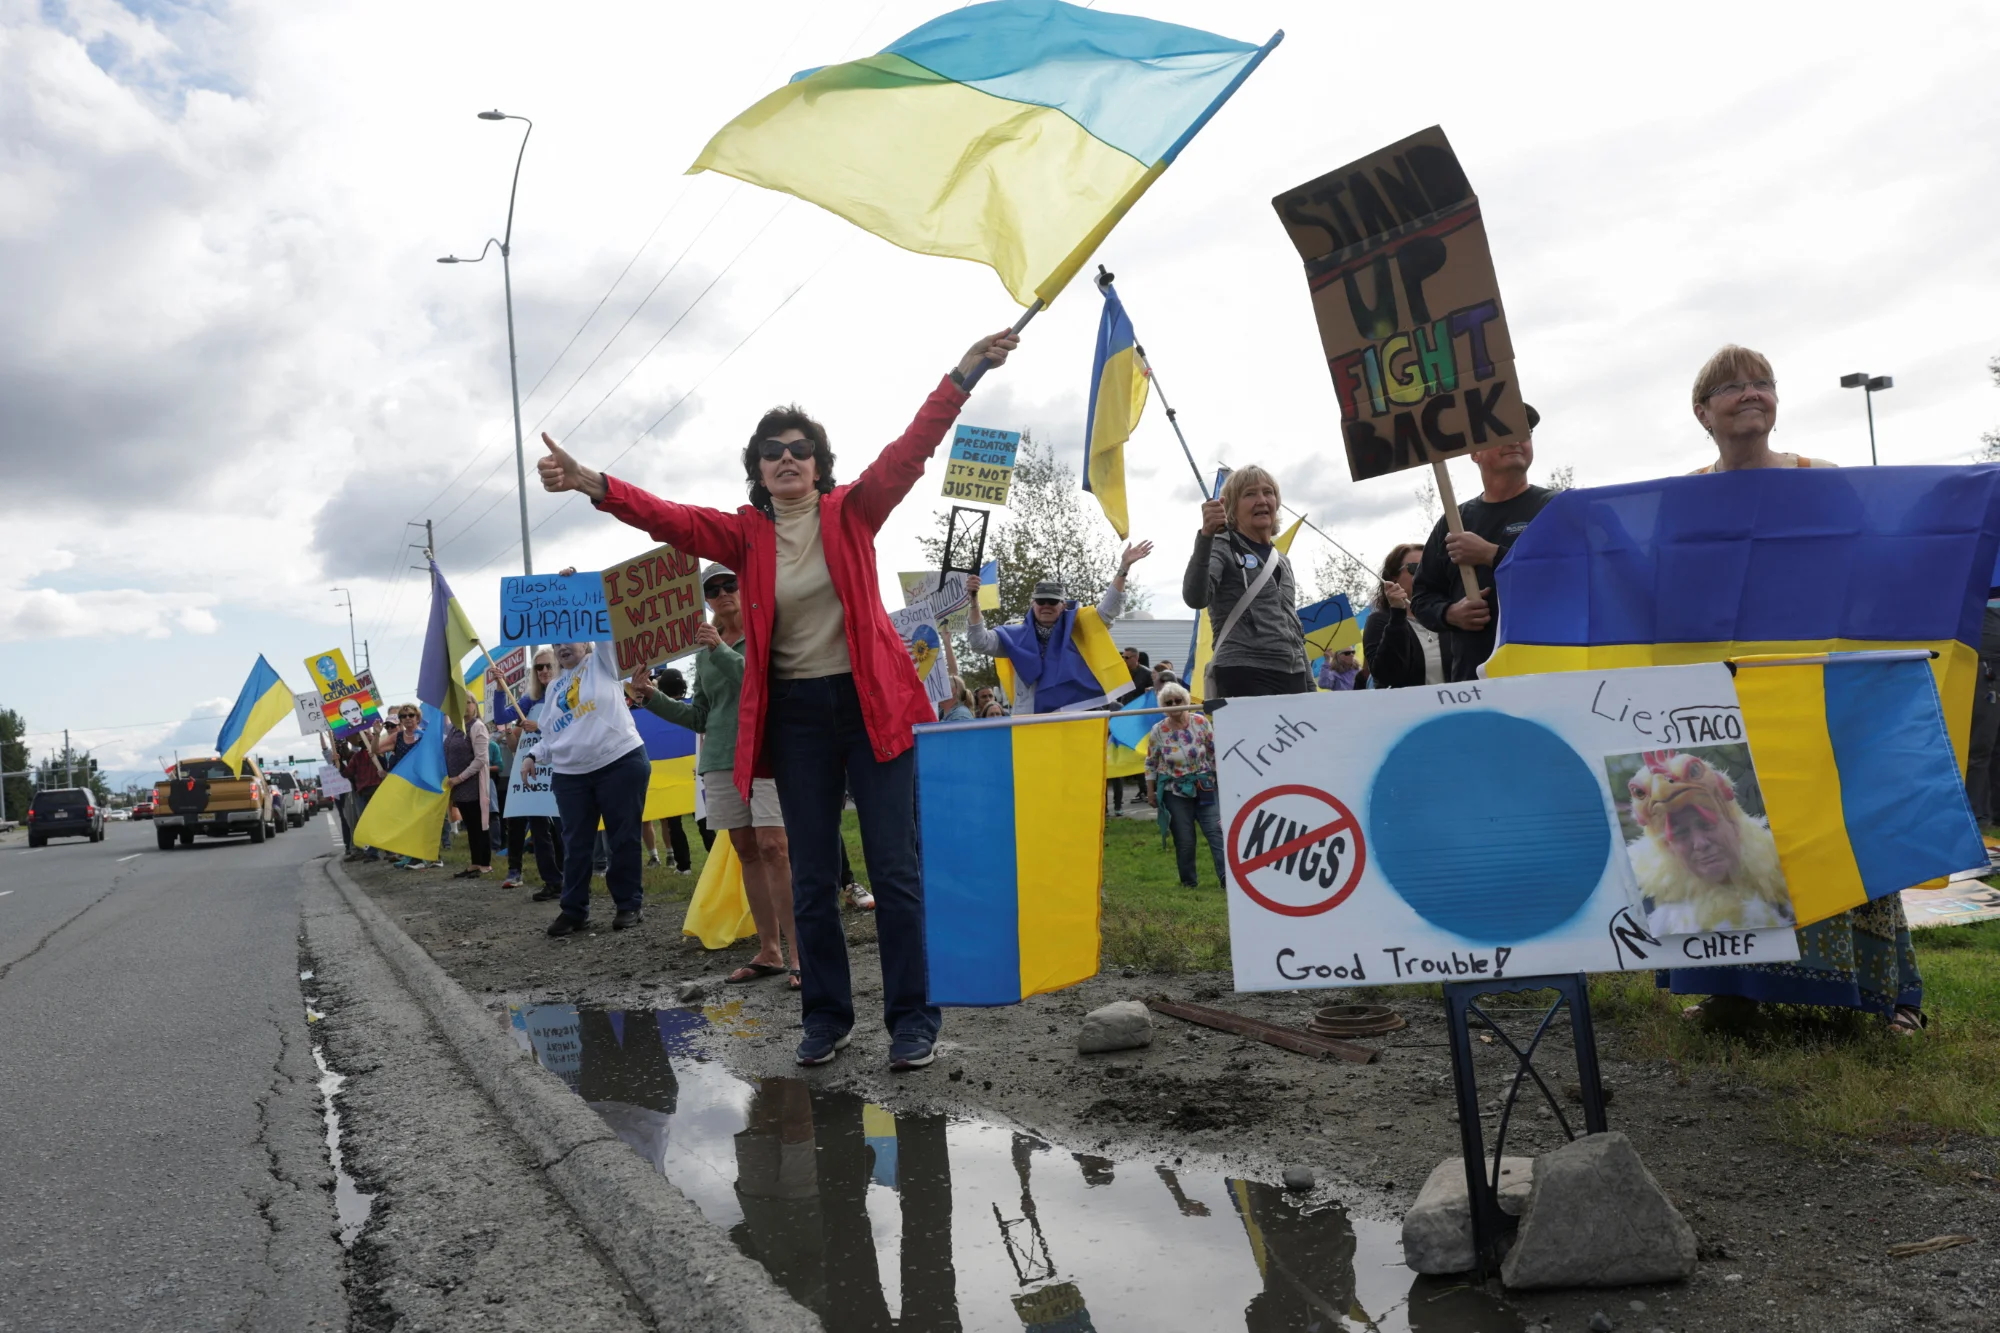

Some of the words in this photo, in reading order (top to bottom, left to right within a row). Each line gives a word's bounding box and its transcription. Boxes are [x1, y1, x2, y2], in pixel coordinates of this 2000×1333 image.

[1284, 145, 1468, 256] STAND
[1342, 236, 1447, 340] UP
[1330, 298, 1499, 421] FIGHT
[955, 437, 1018, 453] PREDATORS
[970, 428, 1008, 440] WHEN
[1346, 381, 1513, 481] BACK
[962, 450, 1007, 465] DECIDE
[950, 464, 975, 477] IT'S
[978, 467, 1010, 481] NOT
[944, 481, 1005, 501] JUSTICE
[605, 571, 624, 606] I
[626, 549, 699, 598] STAND
[508, 595, 569, 612] Stands
[625, 584, 694, 628] WITH
[900, 600, 933, 626] Stand
[323, 683, 361, 702] CRIMINAL
[327, 678, 345, 692] WAR
[1222, 714, 1317, 776] Truth
[1438, 685, 1482, 705] not
[1677, 714, 1741, 742] TACO
[1242, 809, 1346, 889] KINGS
[1683, 931, 1756, 960] CHIEF
[1276, 948, 1366, 980] Good
[1383, 947, 1512, 978] Trouble!
